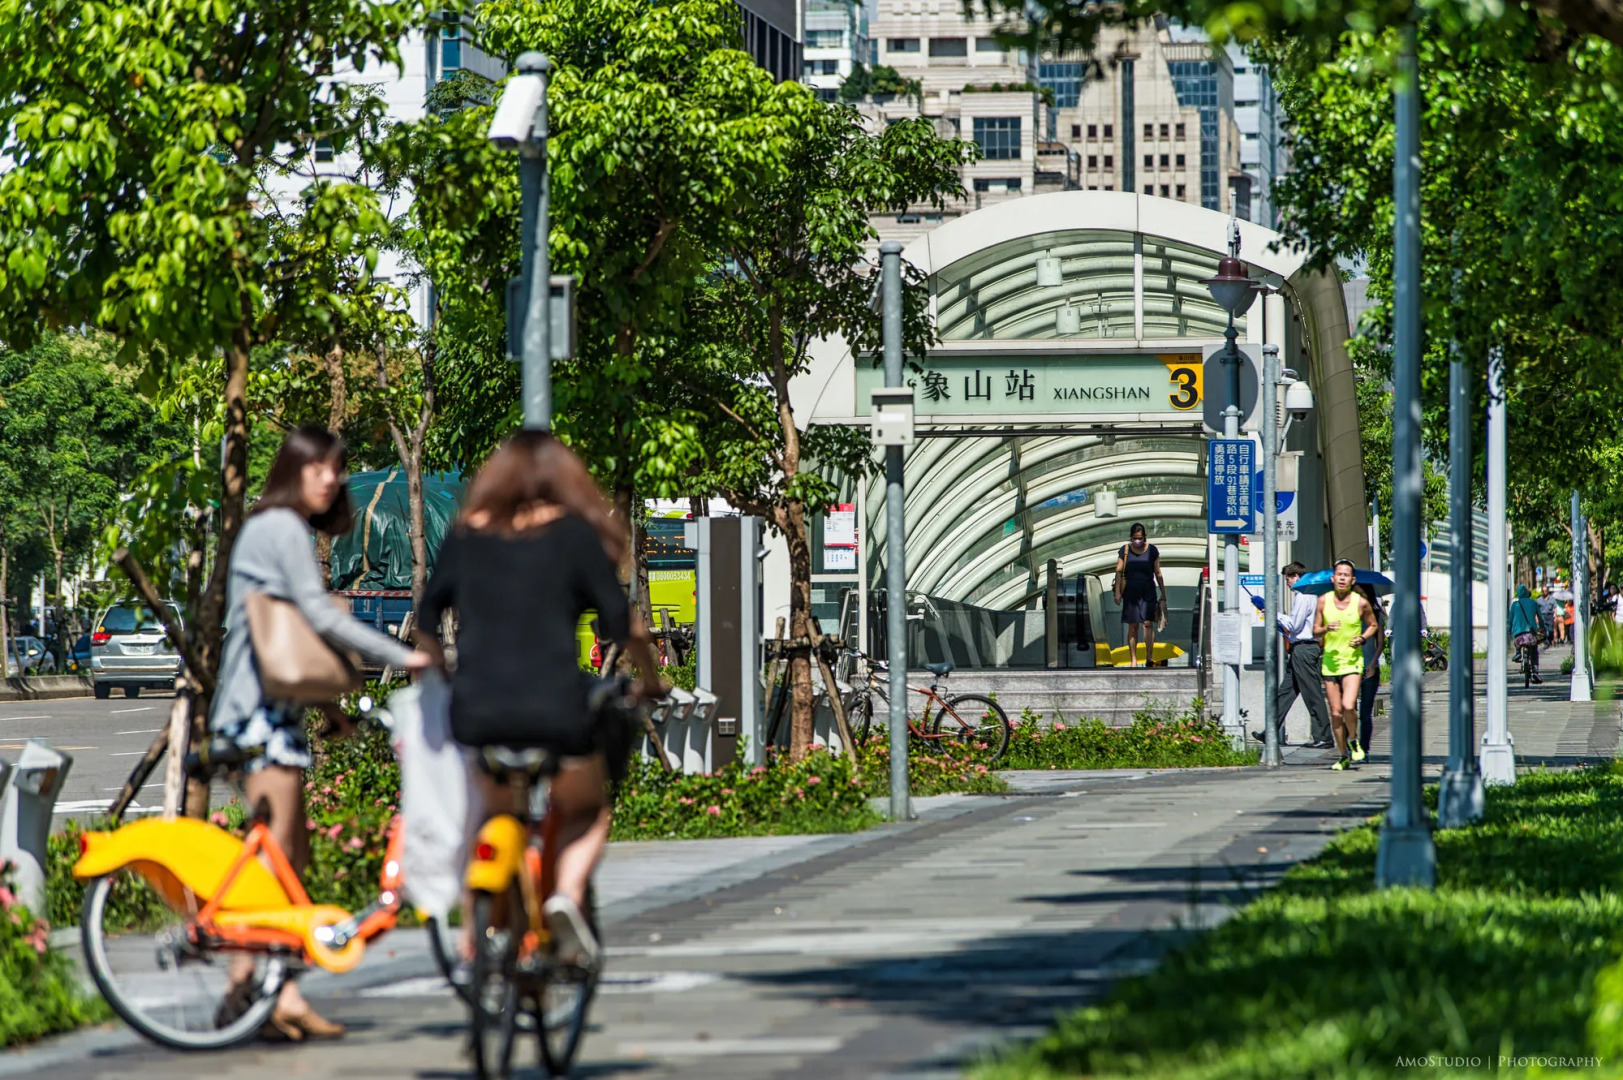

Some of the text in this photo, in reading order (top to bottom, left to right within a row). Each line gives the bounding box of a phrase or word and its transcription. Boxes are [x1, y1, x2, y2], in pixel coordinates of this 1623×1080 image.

[921, 369, 1035, 401] 象山站
[1053, 386, 1150, 400] XIANGSHAN
[1170, 367, 1199, 408] 3
[1214, 444, 1225, 485] 勇路停放
[1239, 444, 1250, 516] 自行車請至信義
